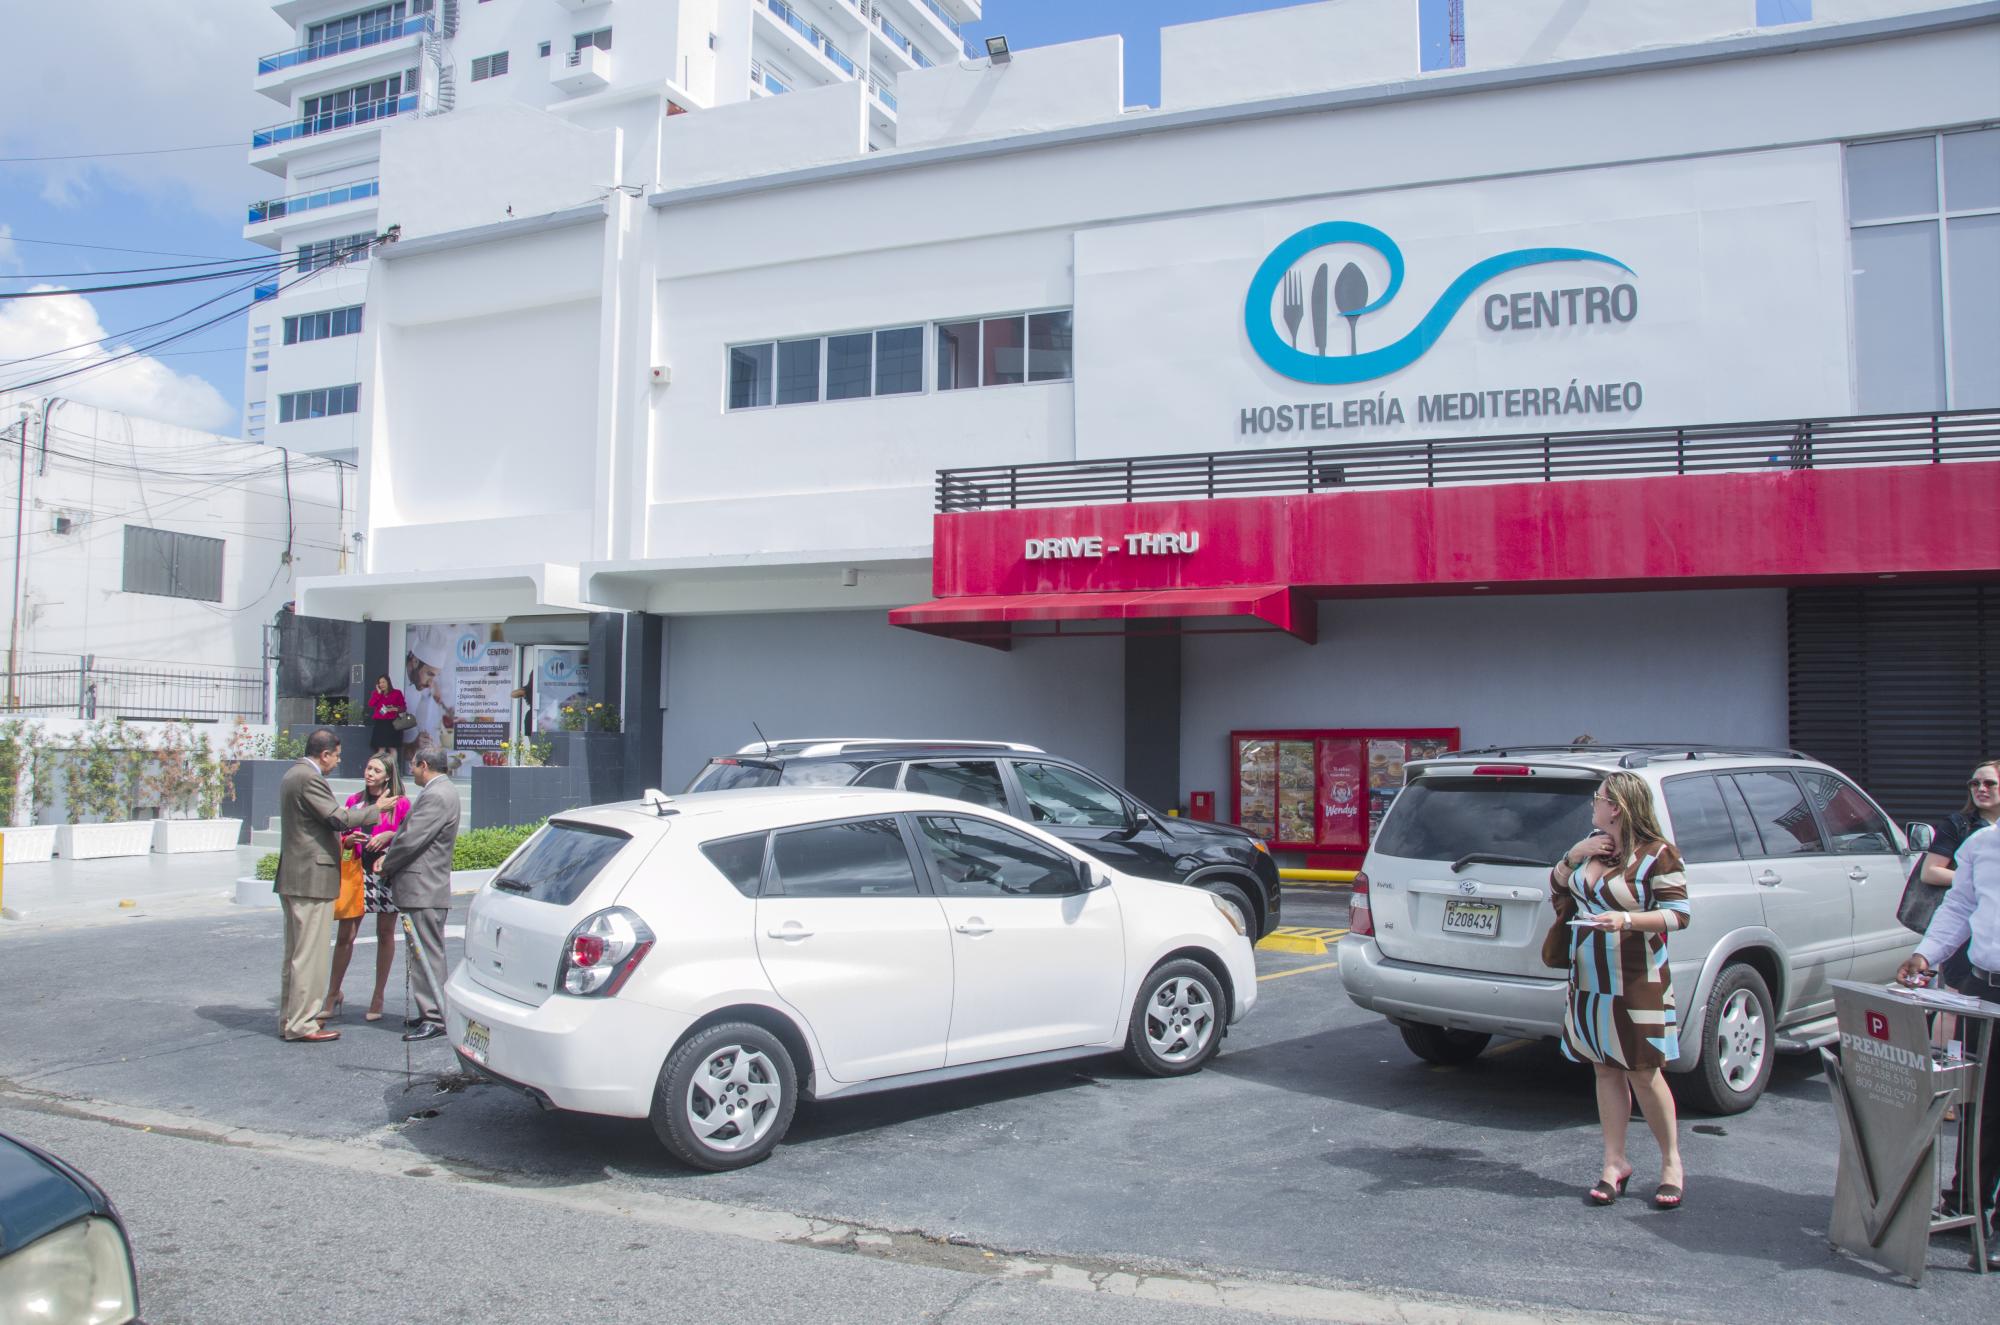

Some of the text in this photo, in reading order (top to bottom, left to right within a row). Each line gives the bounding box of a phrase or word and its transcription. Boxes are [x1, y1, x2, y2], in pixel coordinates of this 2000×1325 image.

[1484, 282, 1639, 332] CENTRO
[1240, 378, 1643, 435] HOSTELERÍA MEDITERRÁNEO
[1025, 535, 1103, 560] DRIVE
[1124, 530, 1200, 556] THRU
[487, 648, 509, 656] CENTRO
[1325, 804, 1358, 818] Wendy's
[1447, 911, 1494, 931] G208434
[1872, 1017, 1883, 1034] P
[1841, 1031, 1926, 1072] PREMIUM
[1858, 1055, 1909, 1075] VALET SERVICE
